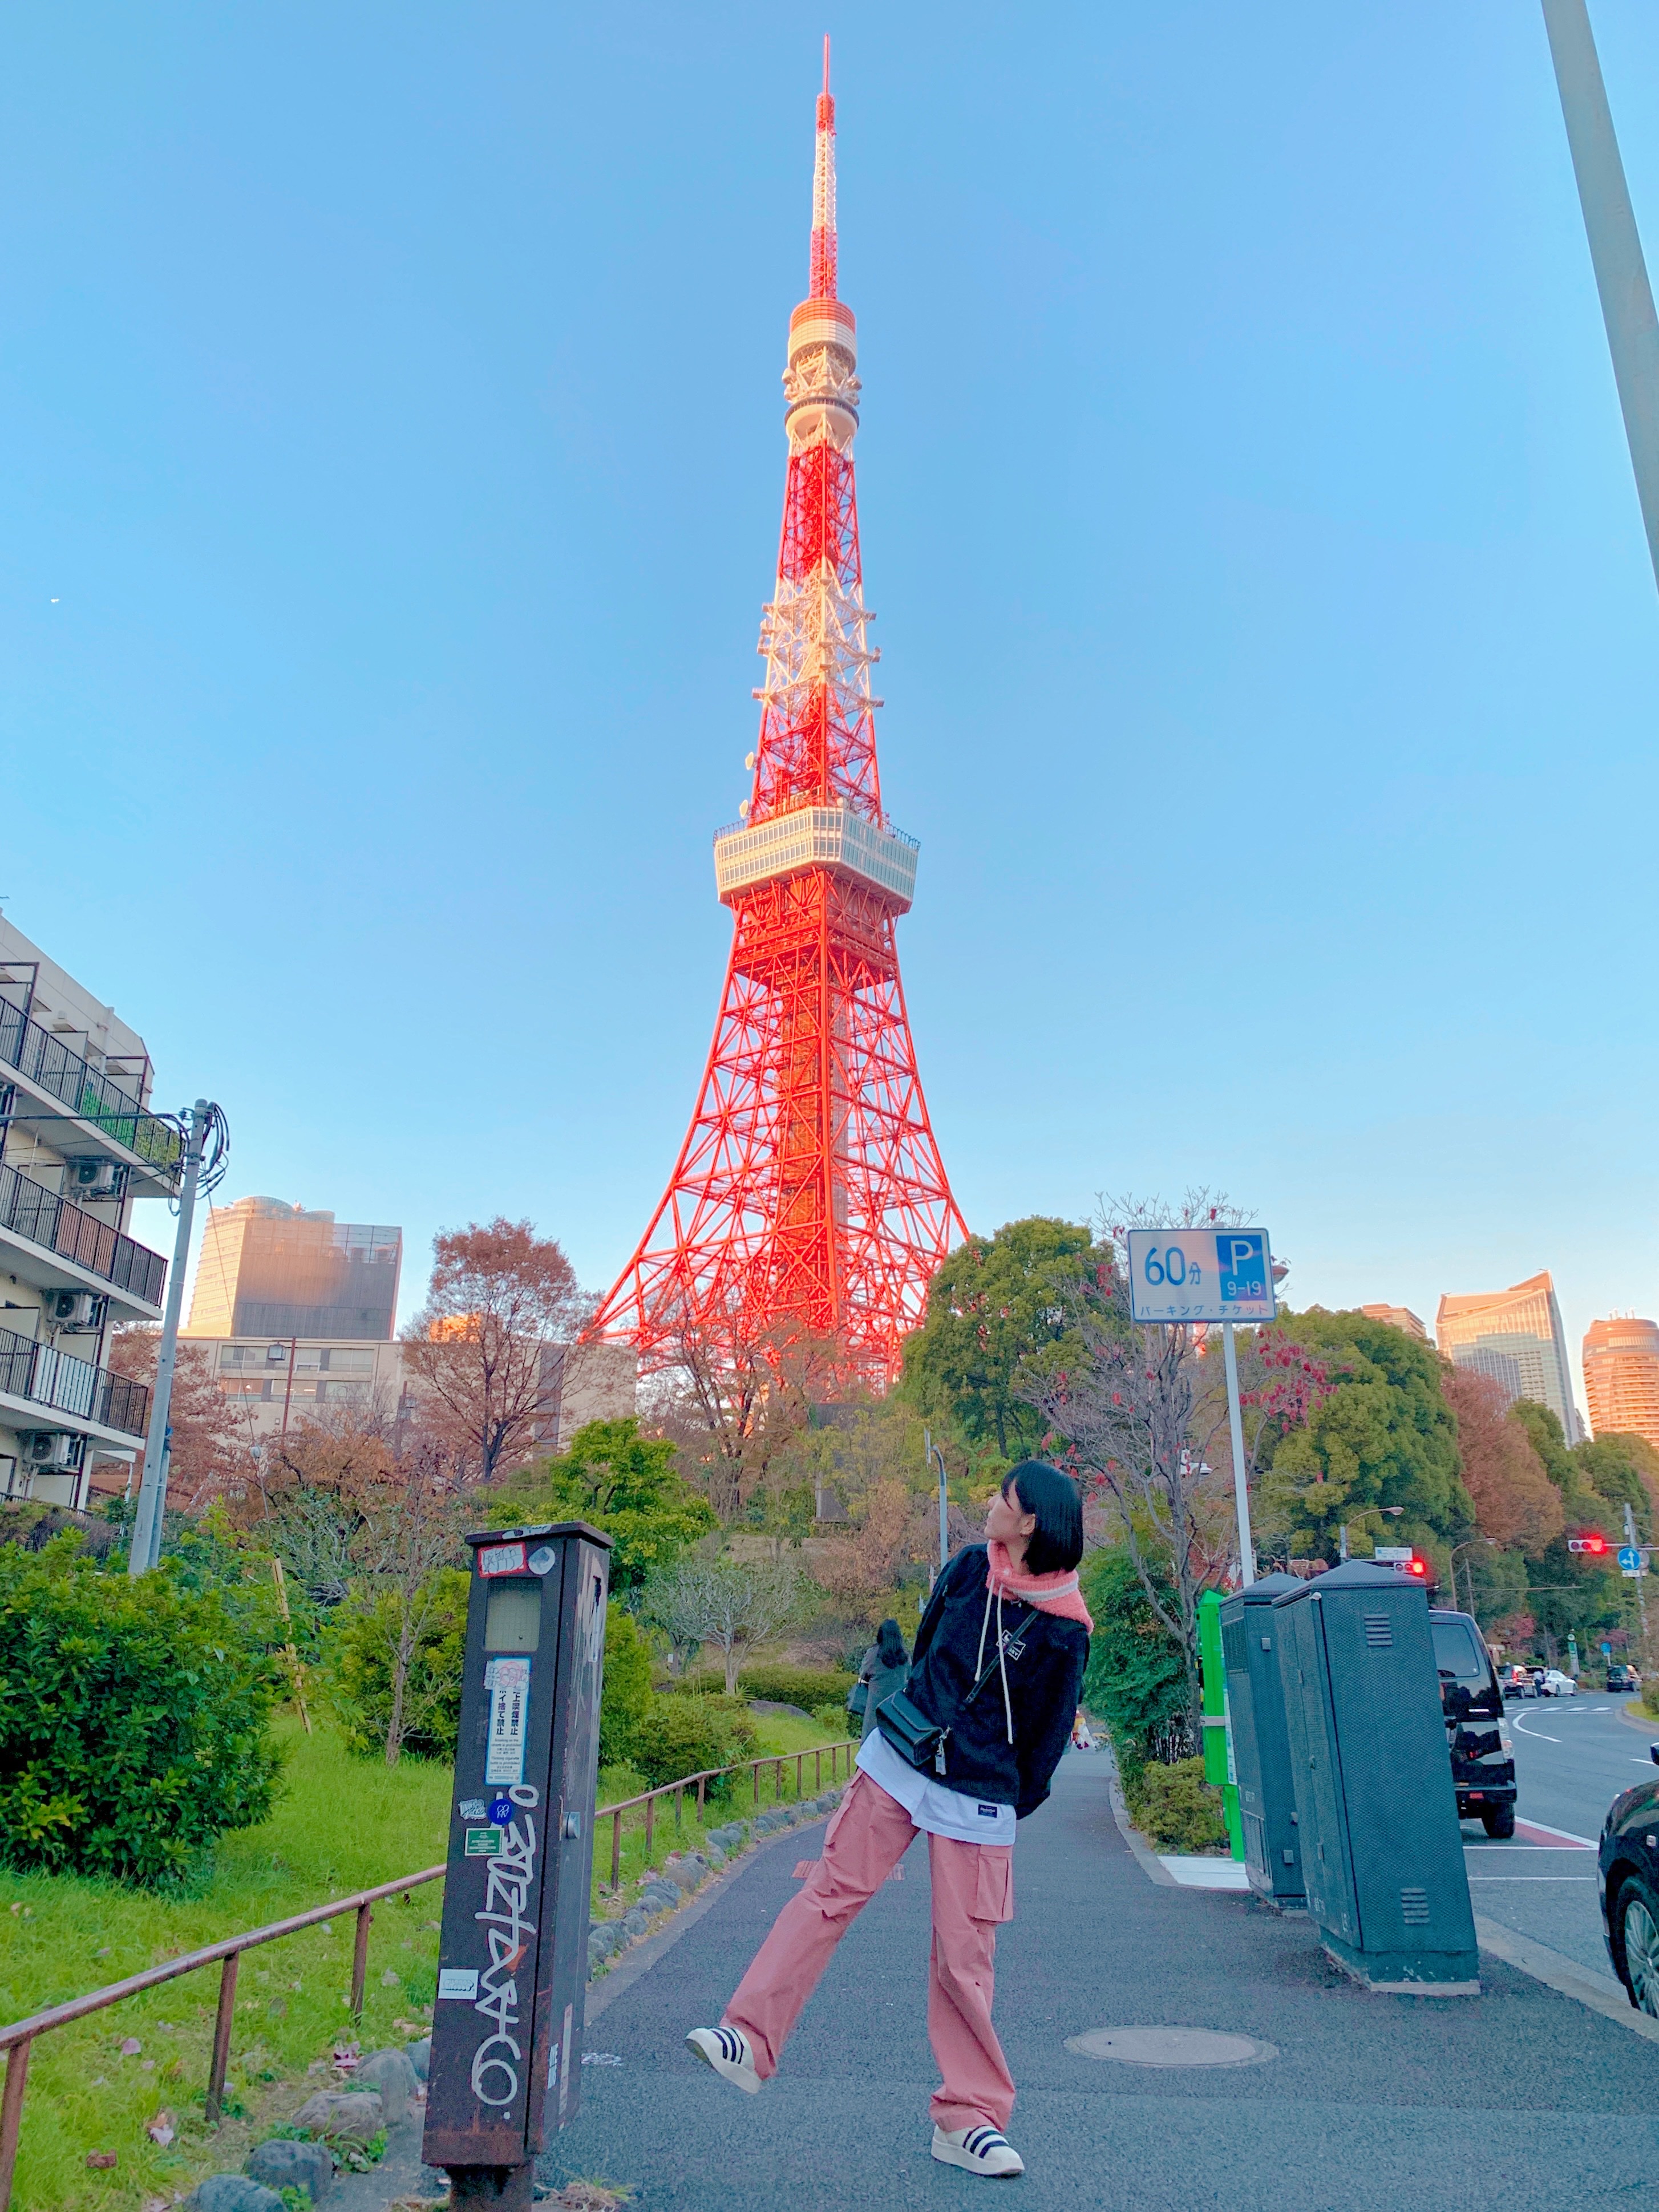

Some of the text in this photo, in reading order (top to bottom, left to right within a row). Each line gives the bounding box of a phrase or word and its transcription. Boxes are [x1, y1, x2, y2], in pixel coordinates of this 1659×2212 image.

[1145, 1246, 1201, 1286] 60分
[1231, 1240, 1253, 1276] P
[1228, 1281, 1261, 1297] 9-19
[510, 1691, 520, 1735] 上喫煙禁止
